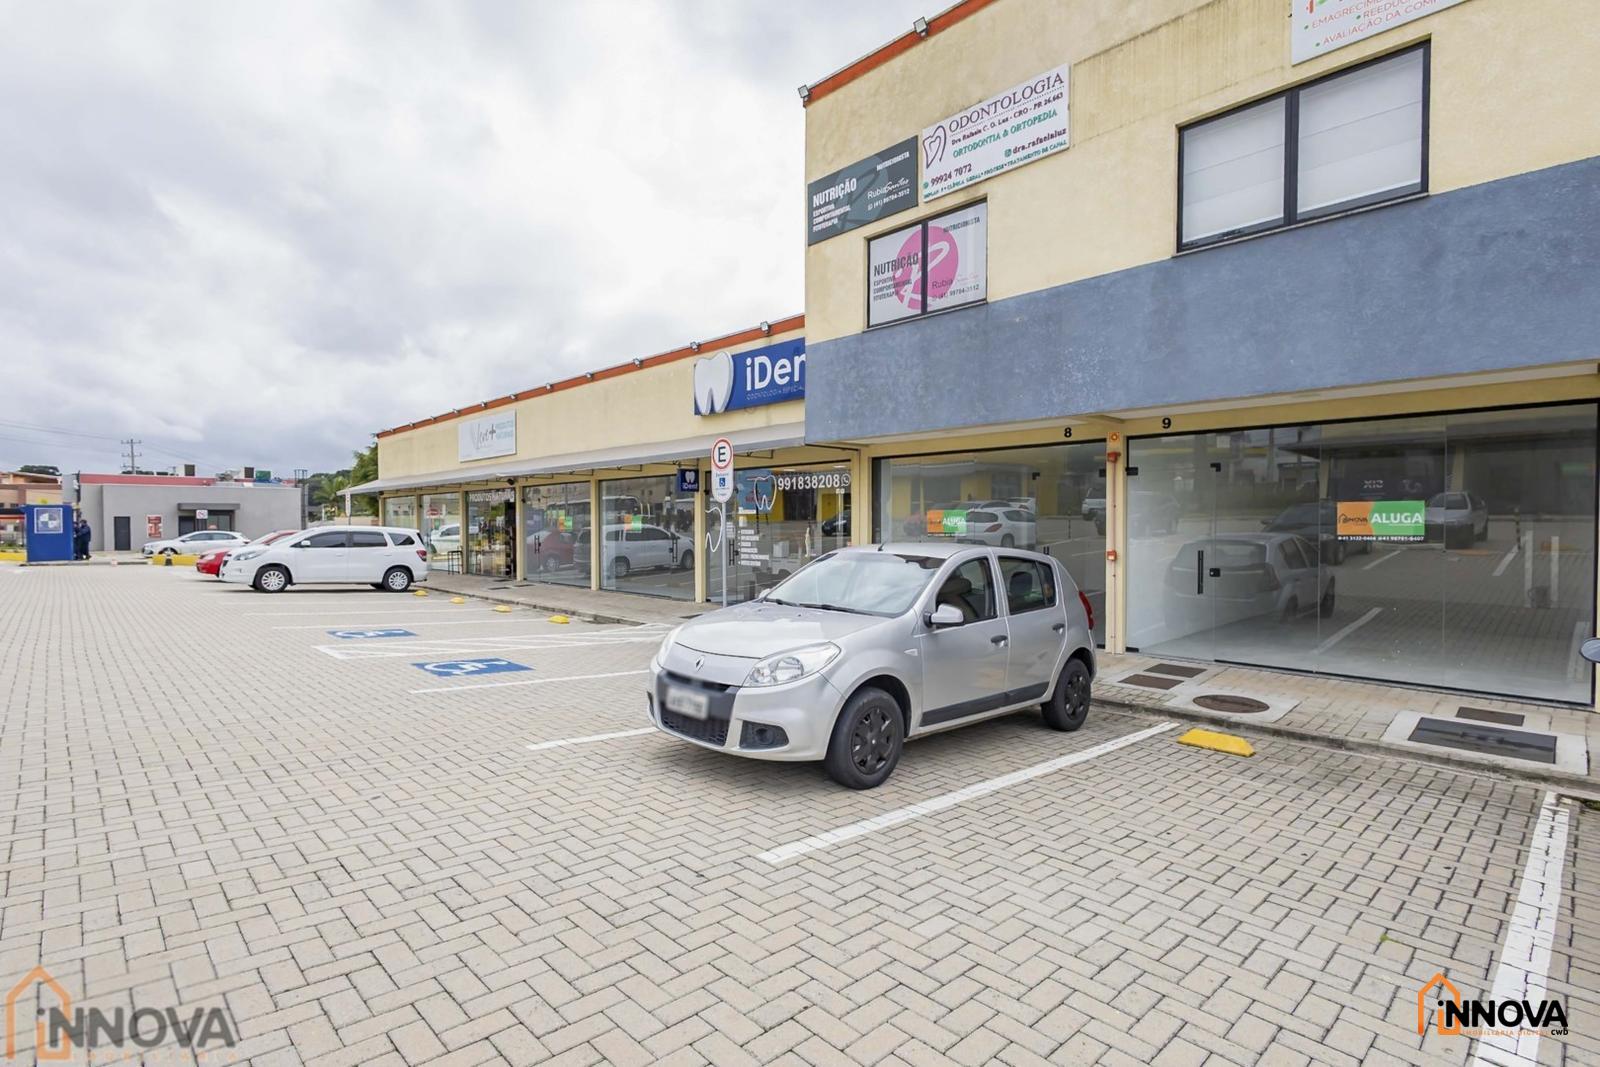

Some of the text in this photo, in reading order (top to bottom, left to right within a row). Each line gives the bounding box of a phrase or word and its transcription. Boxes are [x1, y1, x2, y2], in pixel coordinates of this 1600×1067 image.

[1312, 0, 1382, 28] EMAGRECIM
[949, 73, 1064, 133] ODONTOLOGIA
[953, 109, 1058, 158] ORTODONTIA & ORTOPEDIA
[954, 164, 972, 177] 7072
[813, 178, 857, 207] NUTRIÇÃO
[1162, 417, 1171, 429] 9
[1064, 427, 1072, 438] 8
[717, 446, 727, 463] E
[778, 474, 840, 490] 991838208
[943, 516, 966, 526] ALUGA
[1371, 512, 1424, 524] ALUGA
